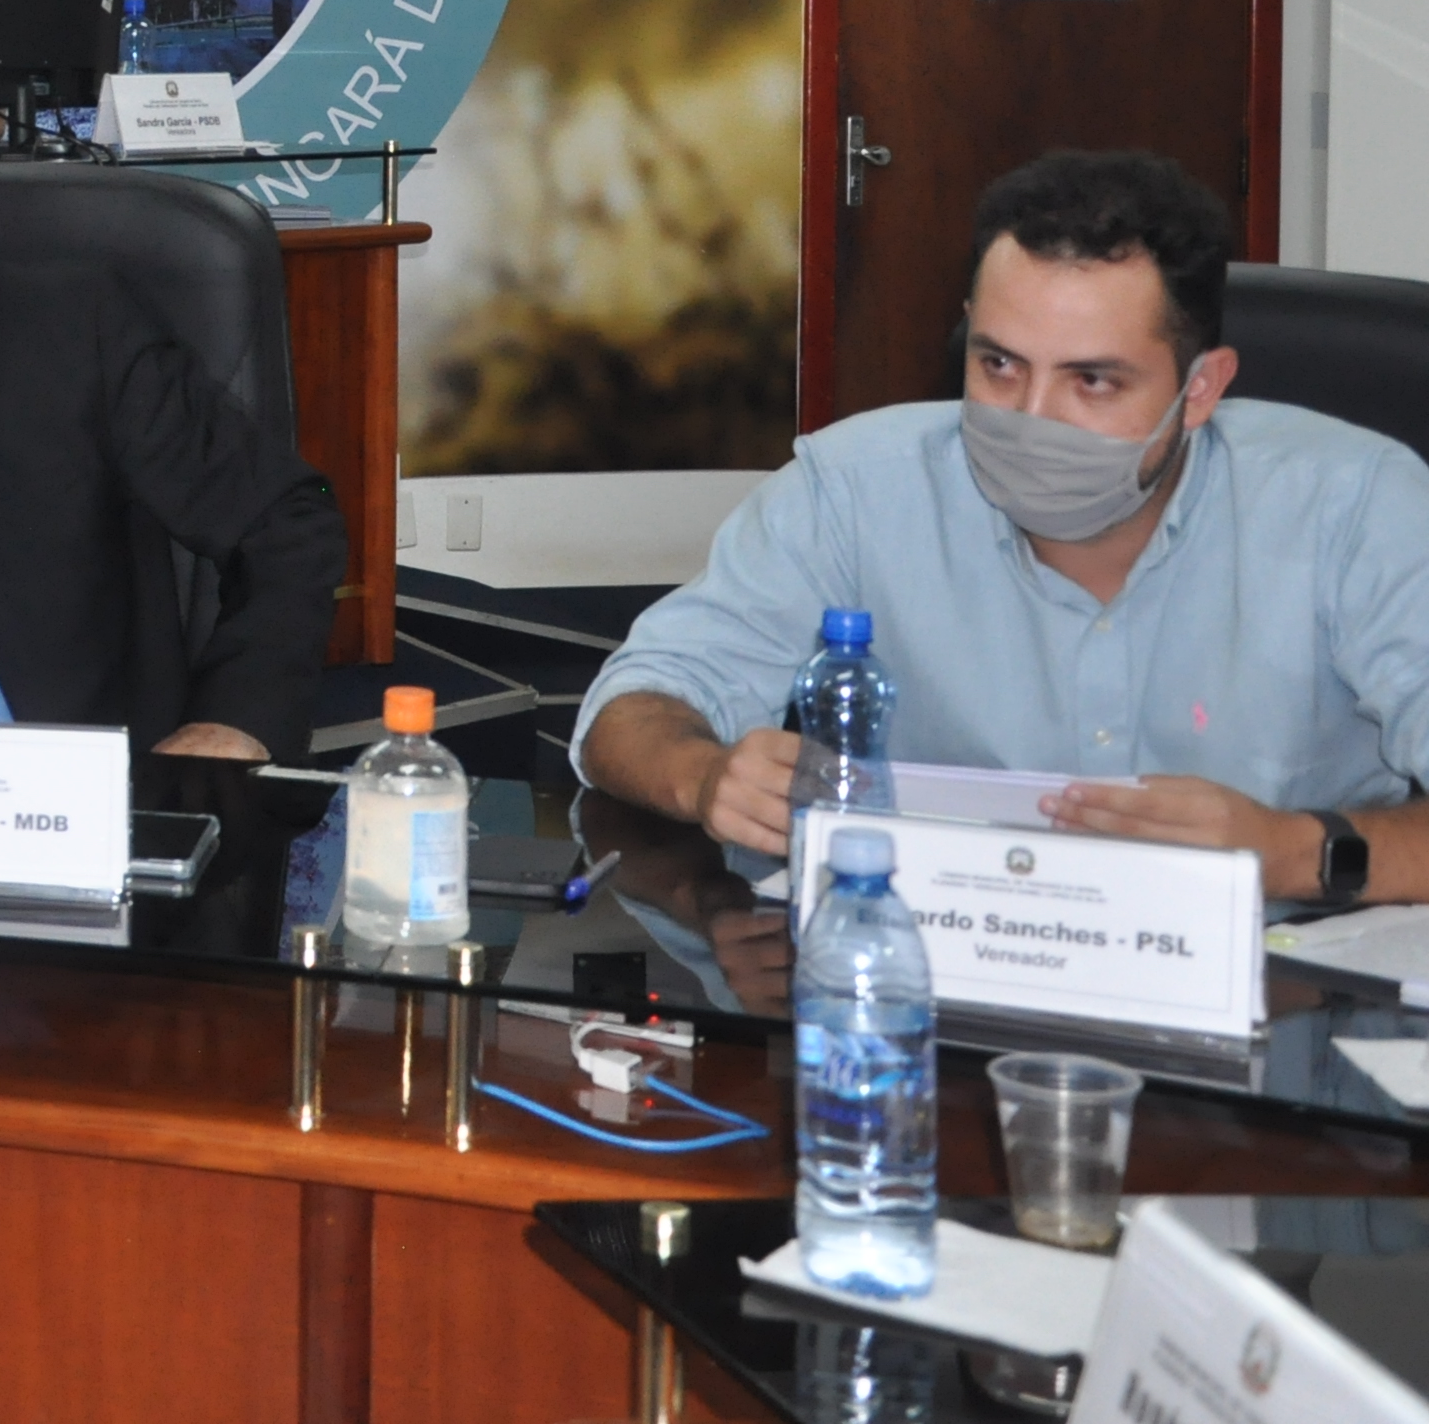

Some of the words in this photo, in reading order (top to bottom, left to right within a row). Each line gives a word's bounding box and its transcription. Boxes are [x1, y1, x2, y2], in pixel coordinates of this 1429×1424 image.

[136, 117, 165, 128] Sandra
[198, 116, 221, 126] PSDB
[13, 814, 69, 832] MDB
[983, 913, 1108, 948] Sanches
[1134, 931, 1194, 958] PSL
[974, 943, 1069, 971] Vereador
